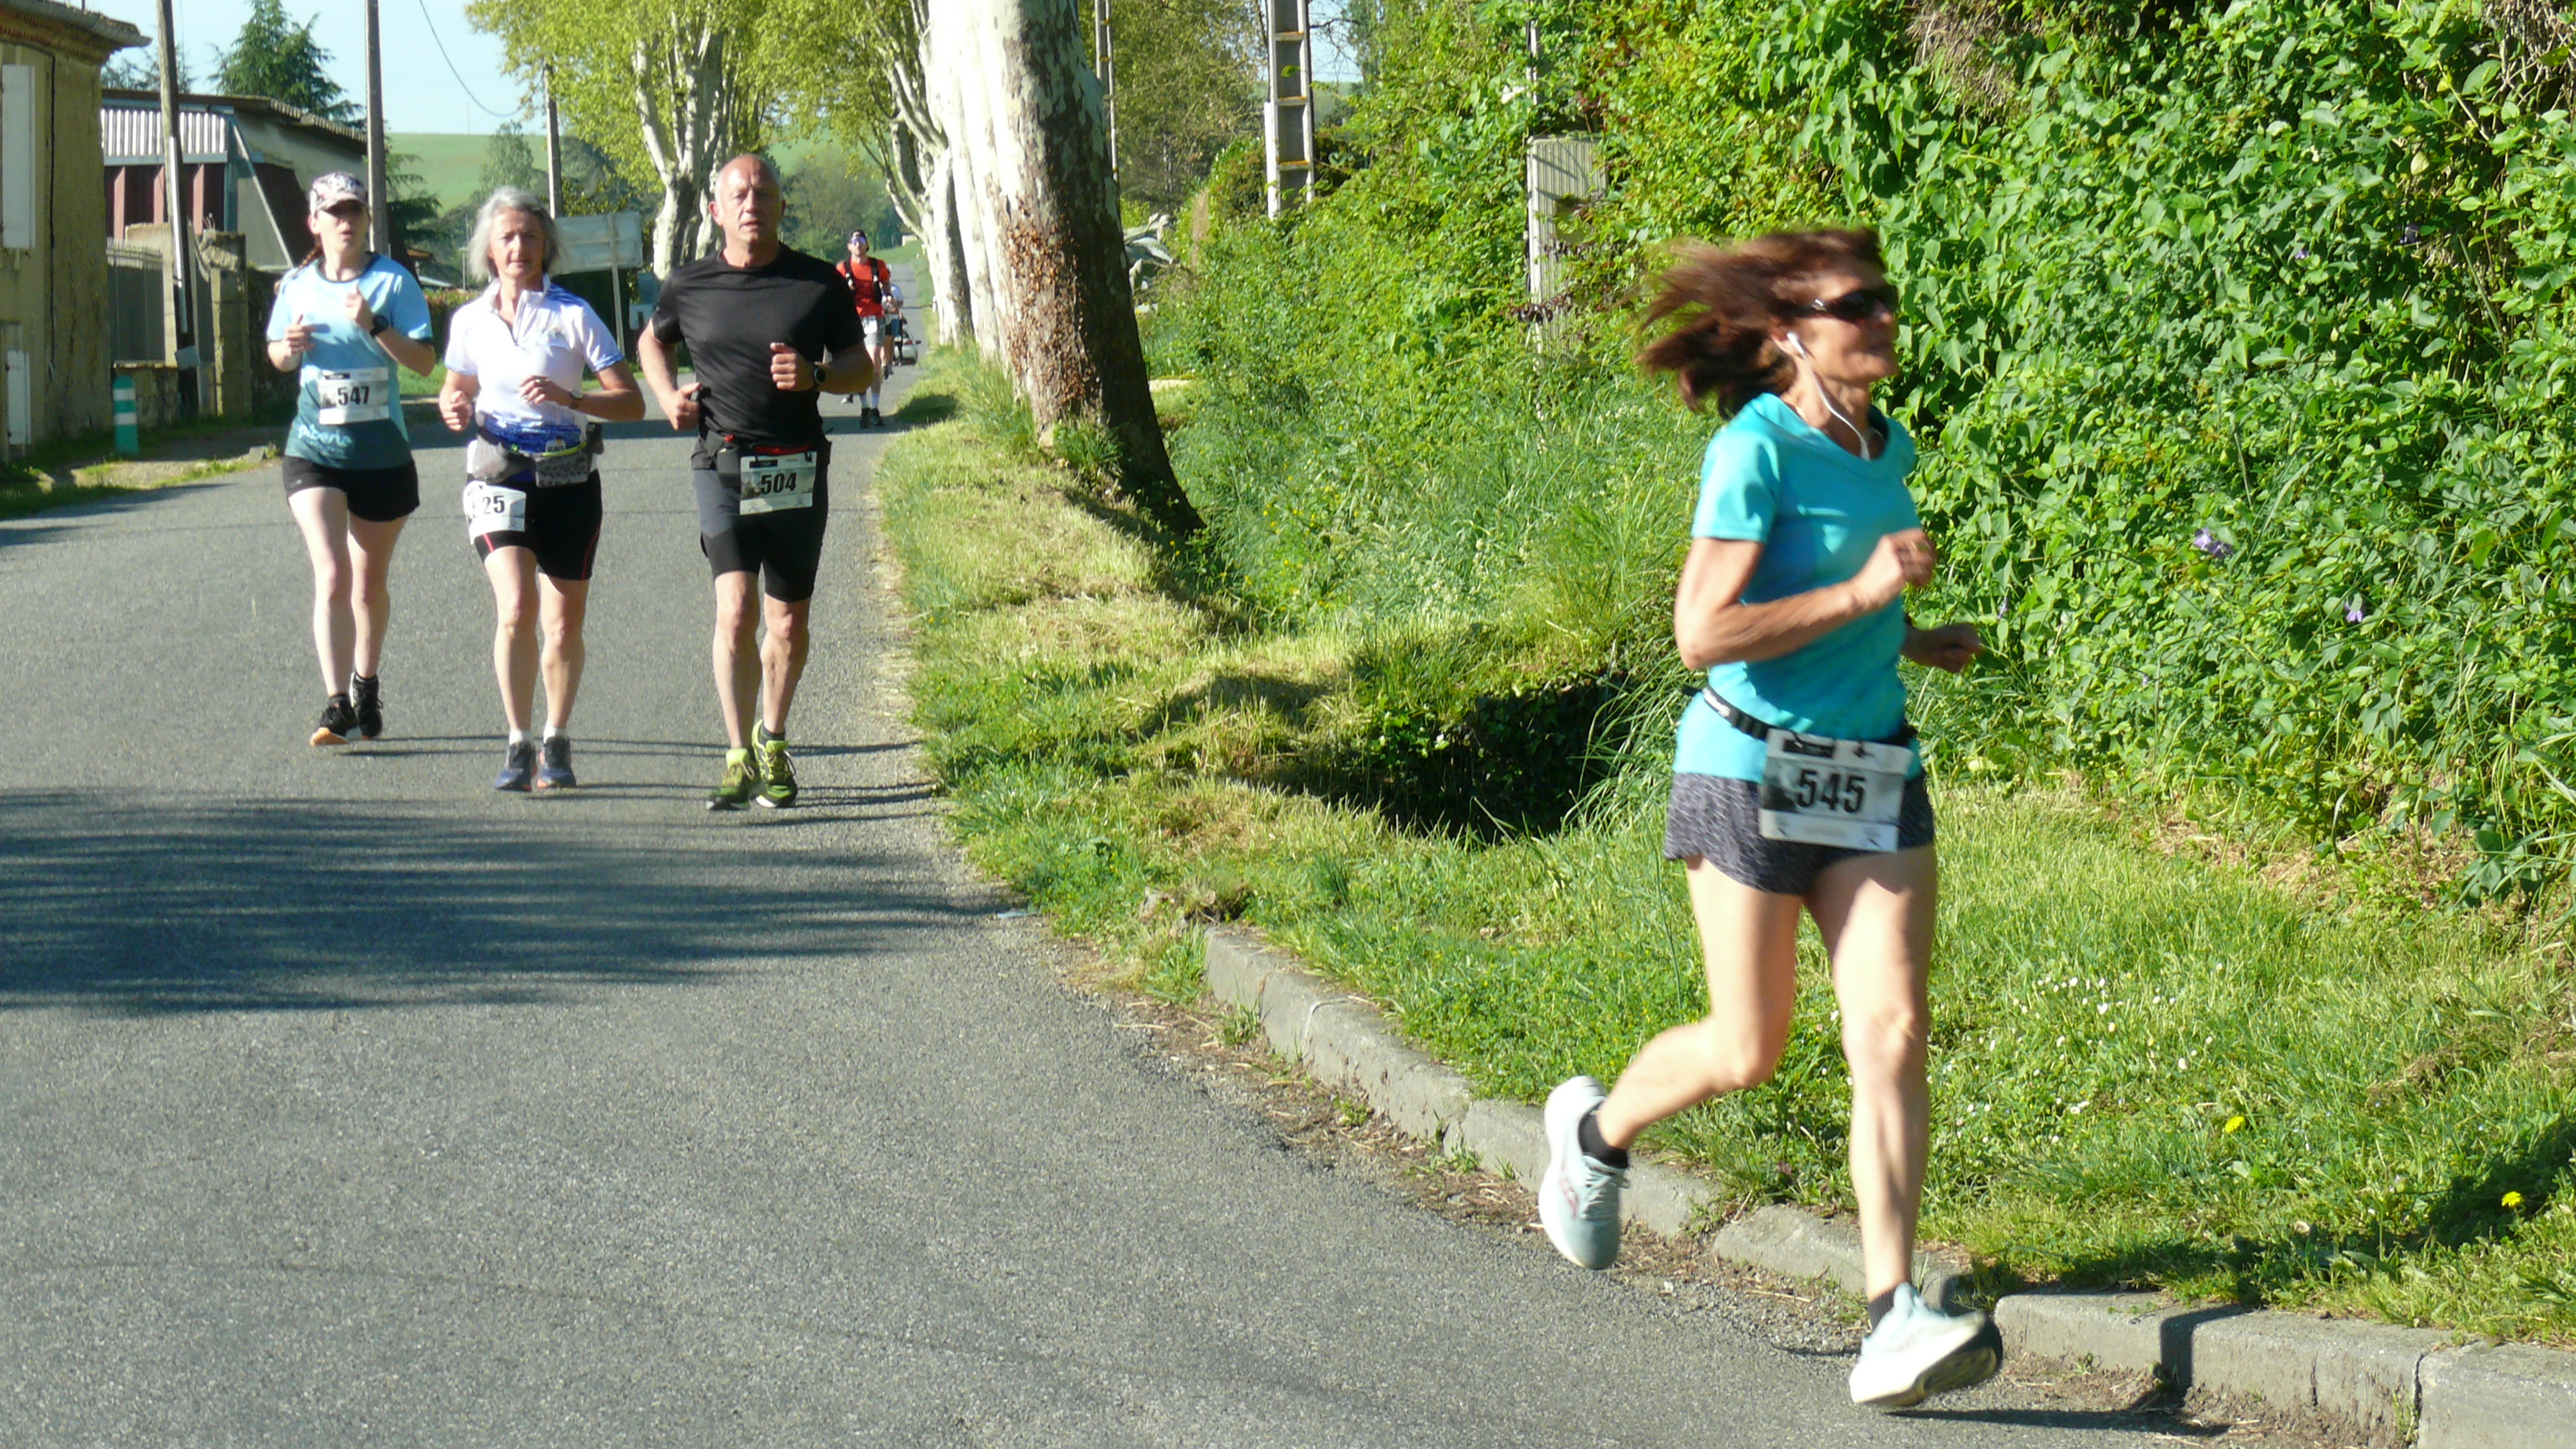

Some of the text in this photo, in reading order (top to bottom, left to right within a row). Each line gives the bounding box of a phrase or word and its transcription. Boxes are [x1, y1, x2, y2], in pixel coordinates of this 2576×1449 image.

[337, 385, 370, 405] 547
[760, 472, 797, 494] 504
[1796, 768, 1867, 813] 545
